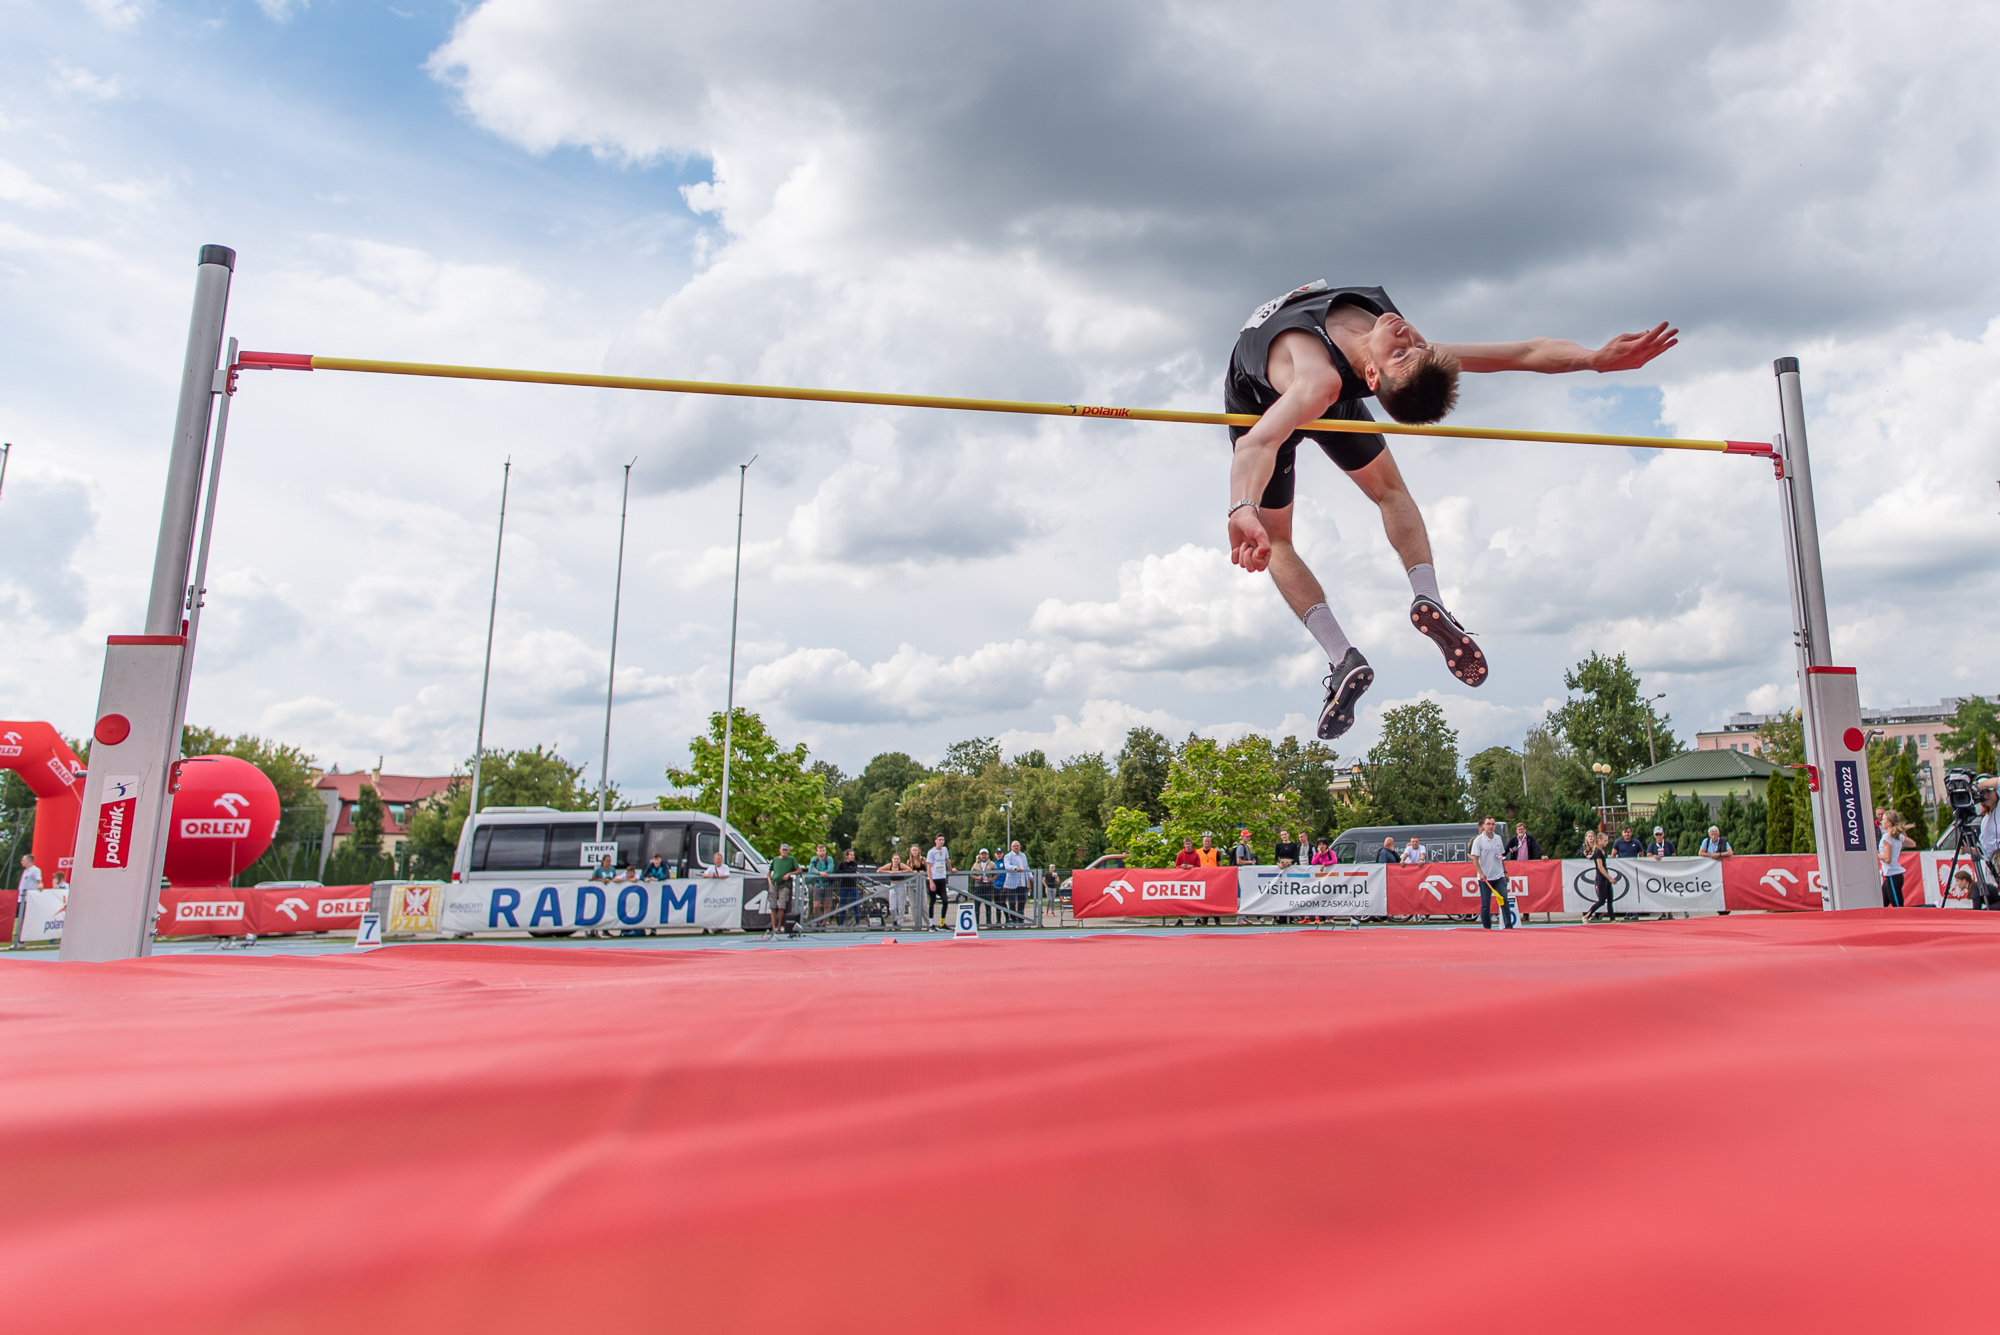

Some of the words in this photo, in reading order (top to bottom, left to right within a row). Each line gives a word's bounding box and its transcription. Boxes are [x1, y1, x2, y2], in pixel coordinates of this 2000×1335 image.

[1081, 406, 1131, 418] polanik
[1841, 766, 1854, 795] 2022
[185, 822, 246, 835] ORLEN
[1845, 797, 1860, 845] RADOM
[106, 805, 124, 865] polanik
[1146, 884, 1201, 897] ORLEN
[1258, 879, 1370, 898] visitRadom.pl
[1646, 876, 1712, 897] Okęcie
[181, 905, 239, 918] ORLEN
[489, 884, 697, 928] RADOM
[1289, 900, 1320, 908] RADOM
[1321, 900, 1370, 908] ZASKAKUJE
[393, 917, 435, 930] PZLA
[960, 910, 973, 930] 6
[364, 920, 378, 940] 7
